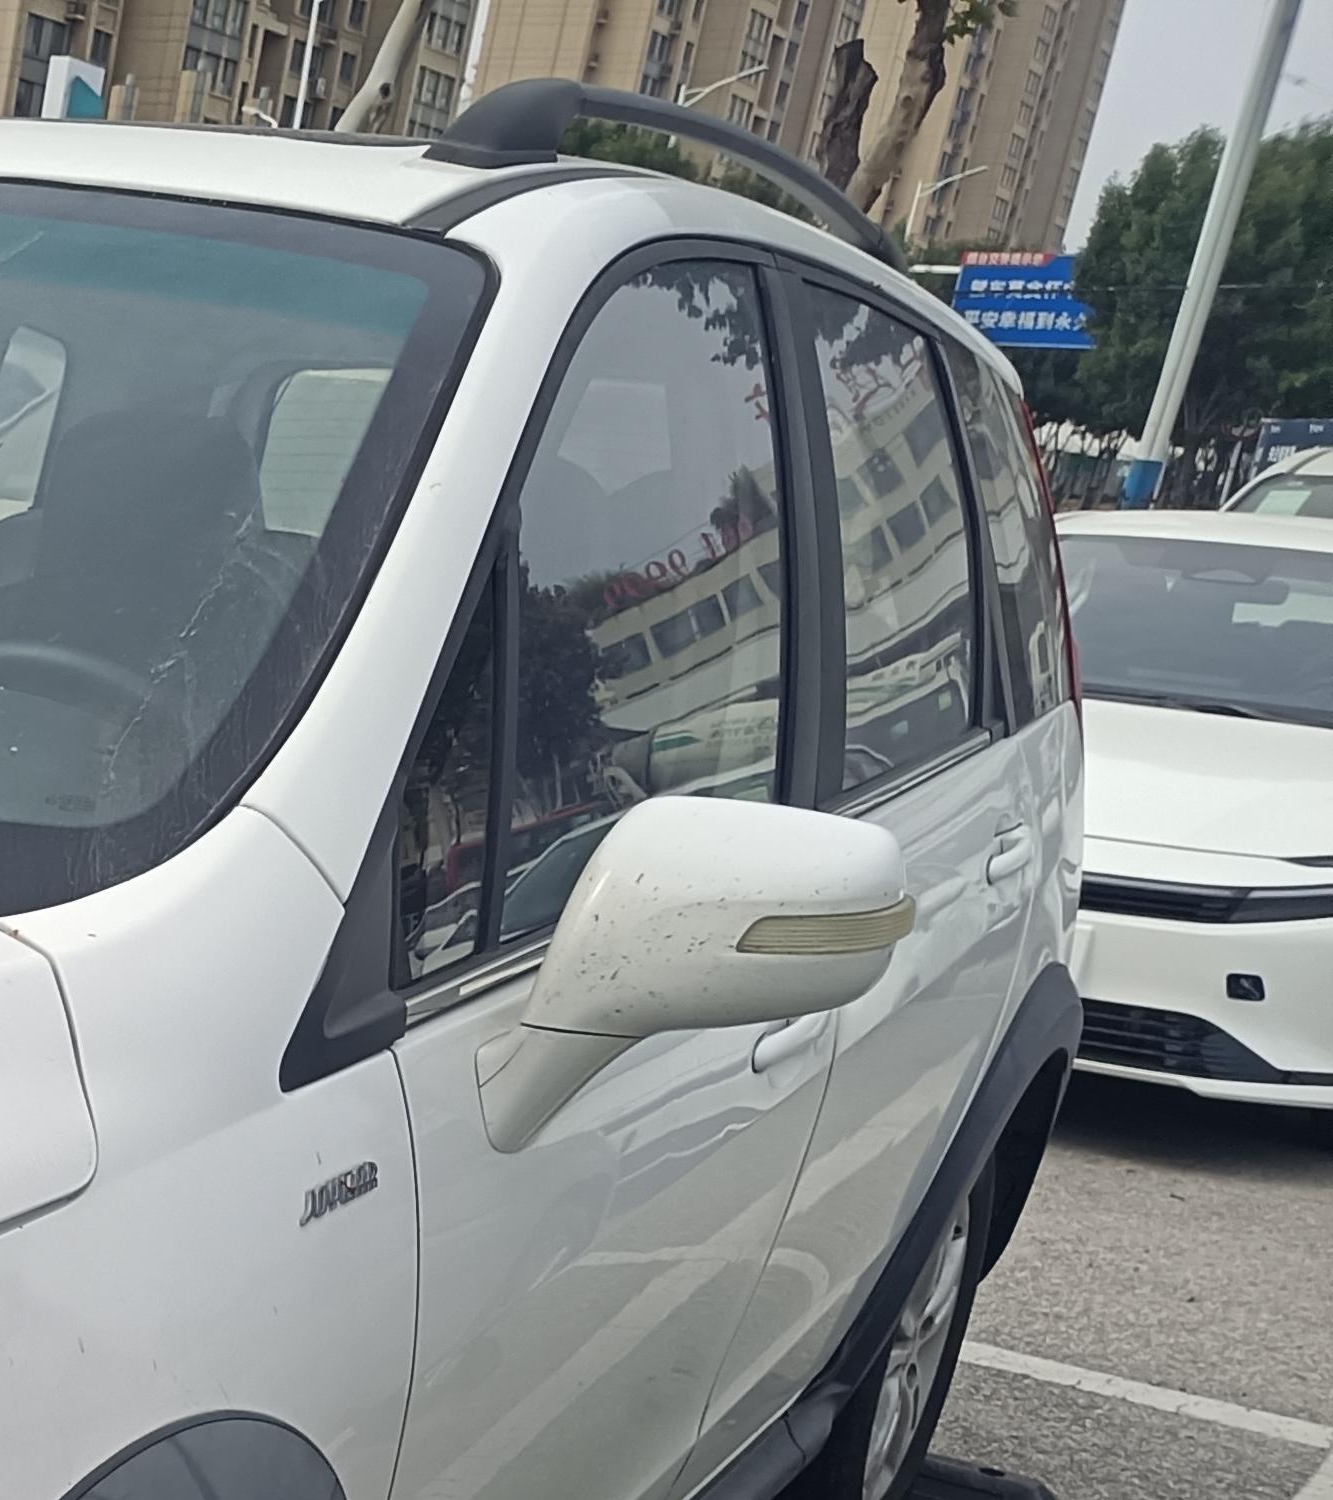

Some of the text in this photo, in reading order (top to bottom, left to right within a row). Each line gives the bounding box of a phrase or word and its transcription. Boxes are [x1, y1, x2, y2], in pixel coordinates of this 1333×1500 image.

[964, 309, 1088, 331] 平安幸福到永久
